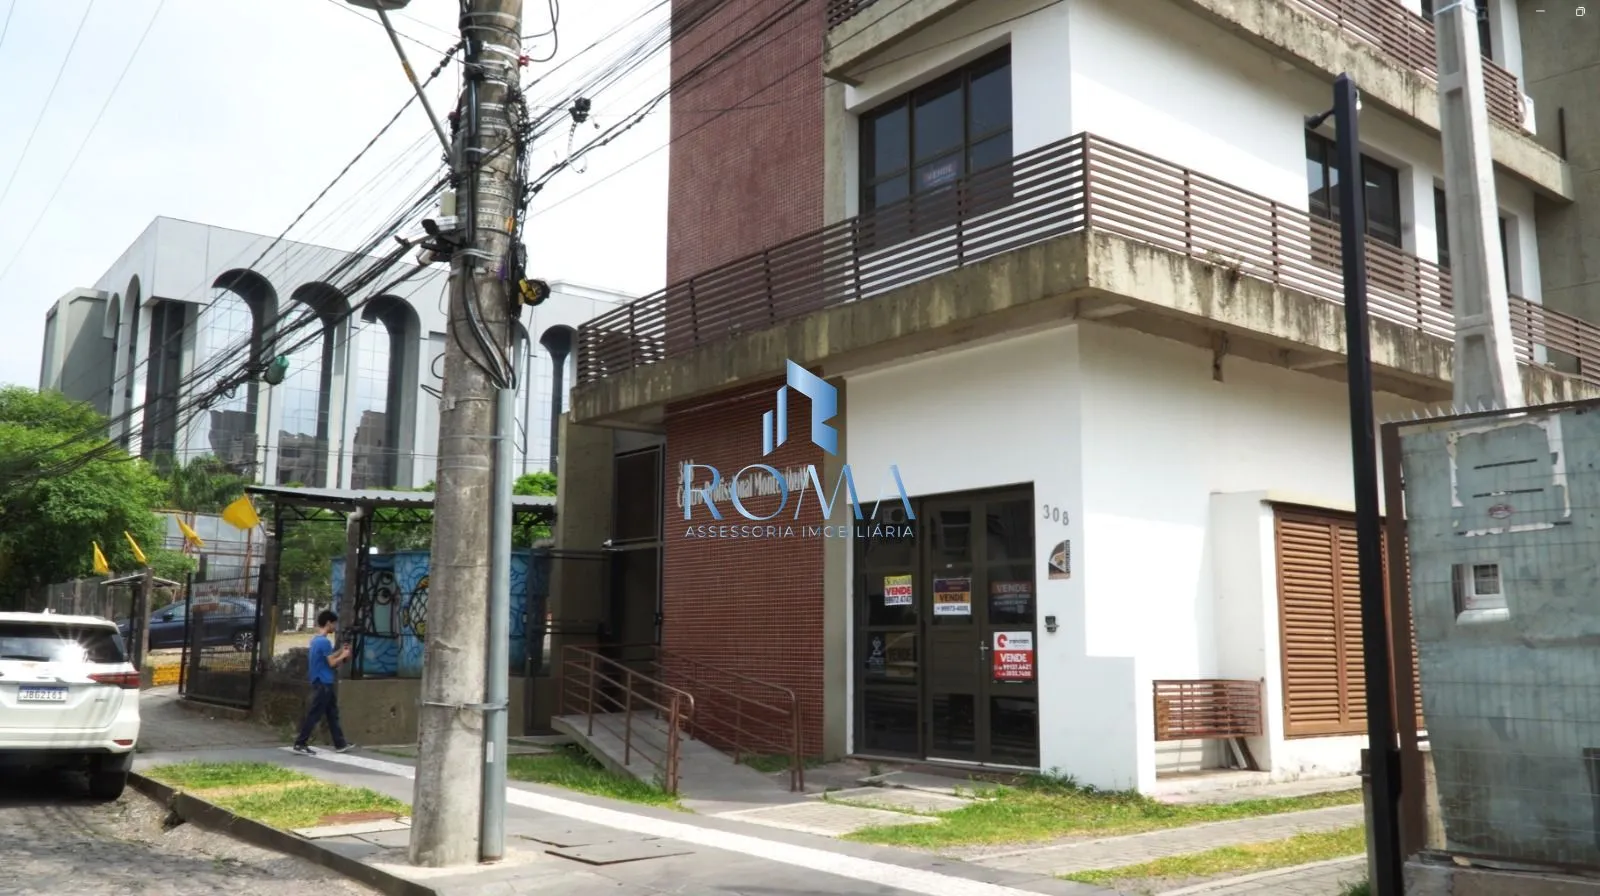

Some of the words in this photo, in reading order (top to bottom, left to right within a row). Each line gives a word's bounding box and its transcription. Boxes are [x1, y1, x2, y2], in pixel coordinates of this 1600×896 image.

[1043, 504, 1069, 526] 308
[885, 586, 912, 596] VENDE
[996, 583, 1029, 593] VENDE
[939, 593, 965, 602] VENDE
[1000, 653, 1027, 662] VENDE
